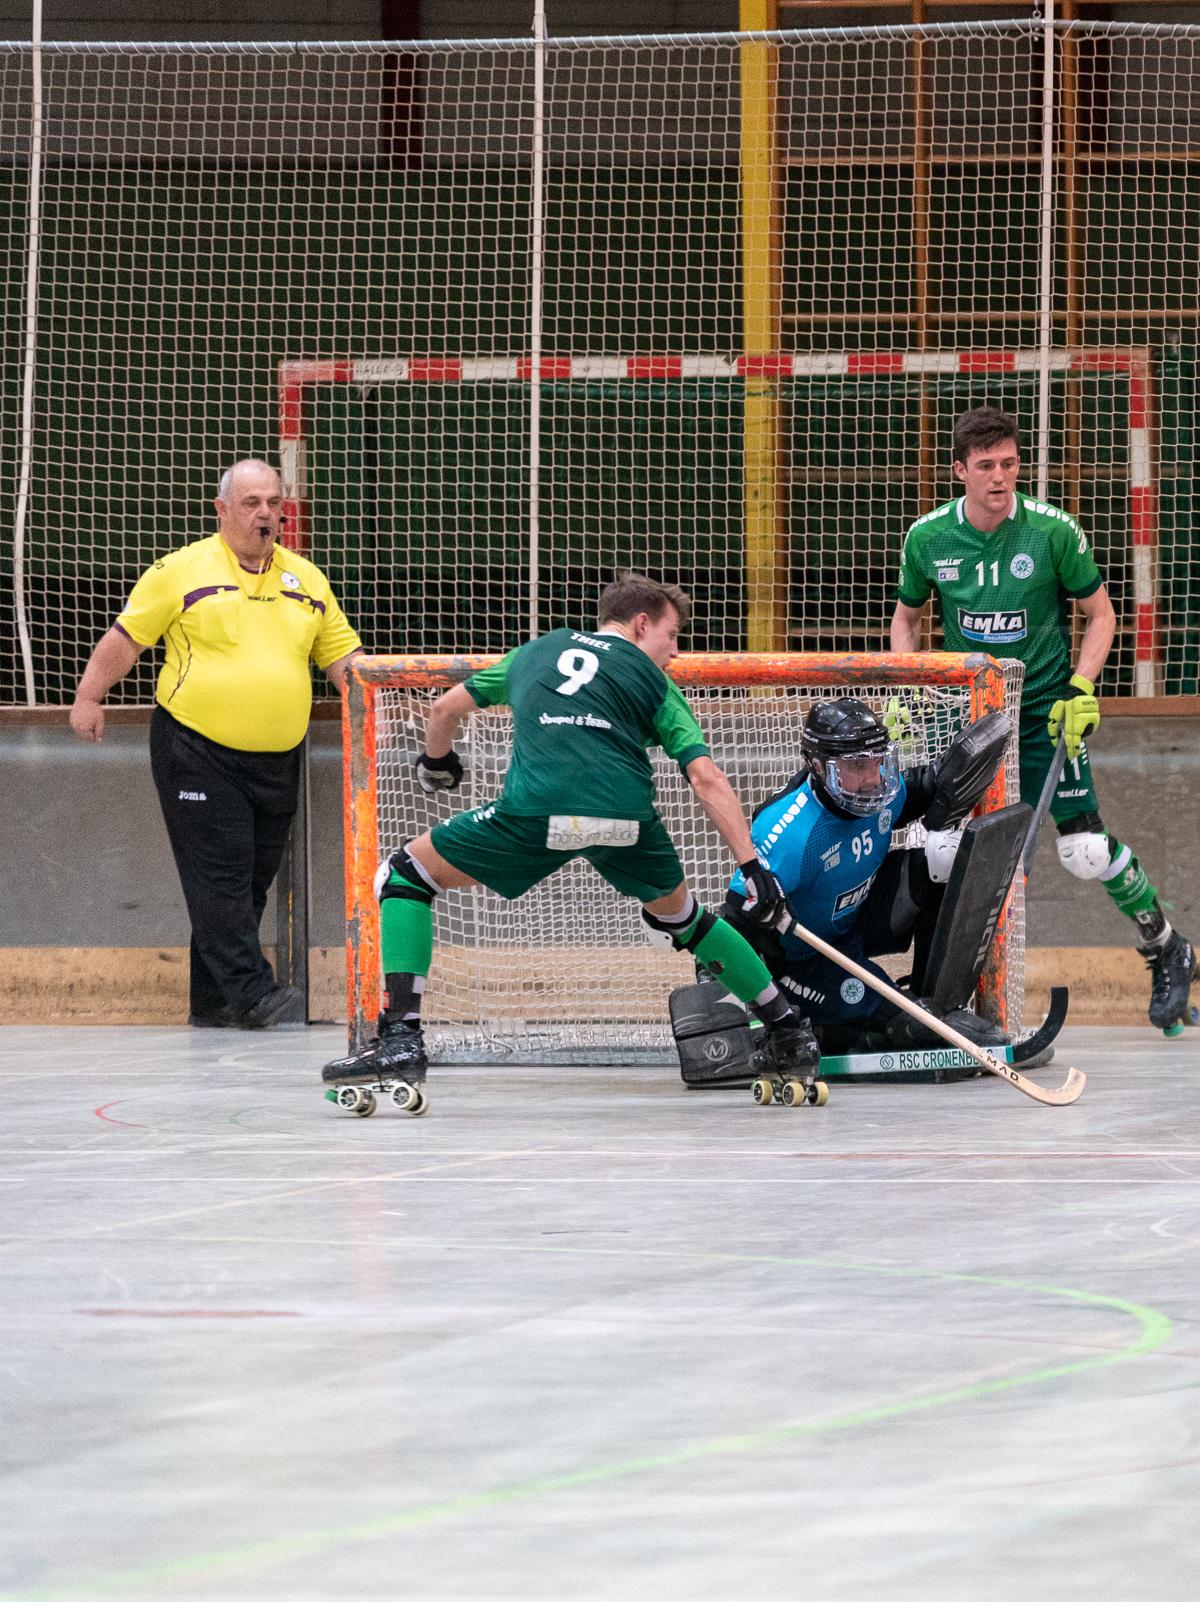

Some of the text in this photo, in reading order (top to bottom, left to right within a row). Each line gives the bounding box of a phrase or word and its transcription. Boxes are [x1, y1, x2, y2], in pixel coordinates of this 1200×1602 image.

[975, 560, 999, 587] 11
[963, 613, 1023, 634] EMKA
[570, 632, 612, 651] THIEL
[555, 648, 600, 696] 9
[851, 829, 873, 863] 95
[899, 1053, 921, 1069] RSC
